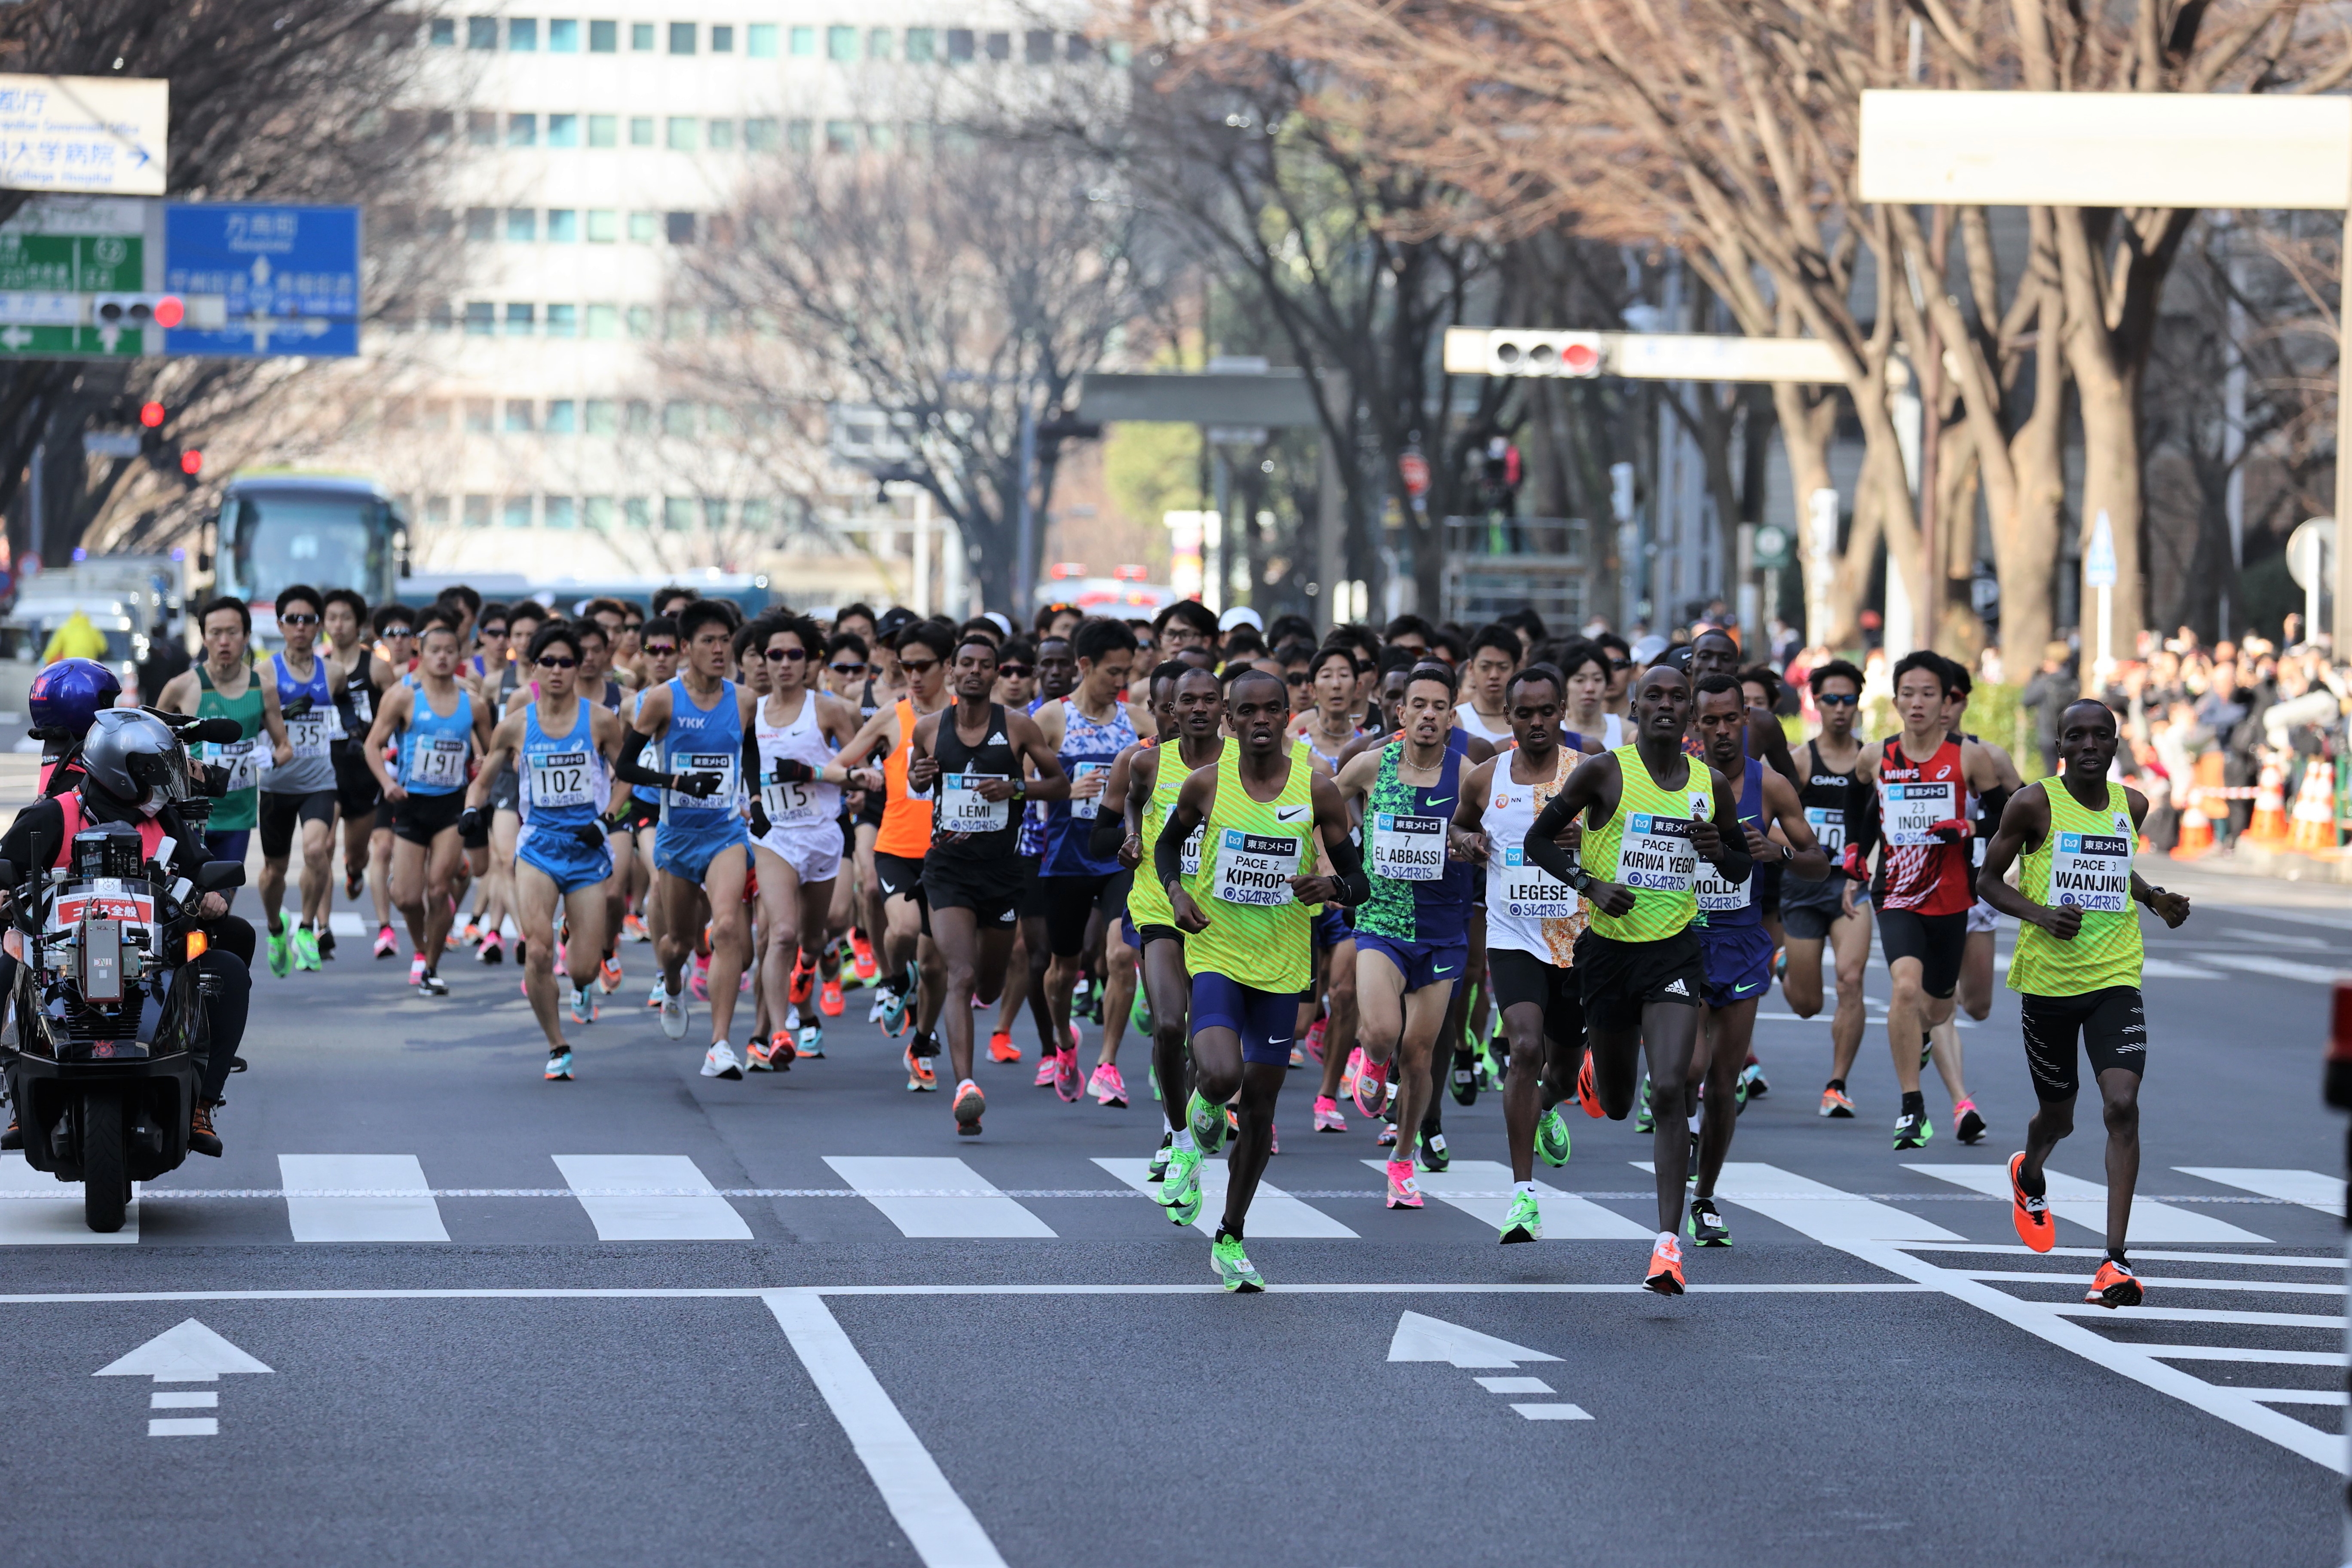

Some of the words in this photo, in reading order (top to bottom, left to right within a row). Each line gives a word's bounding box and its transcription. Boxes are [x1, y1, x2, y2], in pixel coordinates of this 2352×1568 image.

[677, 717, 705, 729] YKK
[424, 752, 456, 774] 191
[1884, 769, 1920, 780] MHPS
[542, 769, 582, 793] 102
[1810, 775, 1849, 787] GMO
[767, 783, 807, 812] 115
[971, 793, 977, 803] 6
[1906, 787, 1946, 797] 東京メトロ
[959, 805, 990, 818] LEMI
[1912, 802, 1926, 814] 23
[1396, 820, 1438, 830] 東京メトロ
[1654, 821, 1698, 833] 東京メ
[1246, 839, 1293, 851] 東京メトロ
[1404, 835, 1411, 847] 7
[1642, 839, 1675, 852] PACE
[2084, 840, 2125, 851] 東京メトロ
[1375, 846, 1385, 861] EL
[1389, 848, 1441, 865] ABBASSI
[1235, 855, 1268, 870] PACE
[1274, 861, 1280, 870] 2
[1623, 850, 1664, 872] KIRWA
[1669, 856, 1695, 874] YEGO
[2073, 858, 2106, 871] PACE
[2111, 861, 2116, 872] 3
[1226, 867, 1286, 889] KIPROP
[2056, 871, 2126, 893] WANJIKU
[1510, 884, 1568, 900] LEGESE
[1665, 986, 1690, 996] adidas
